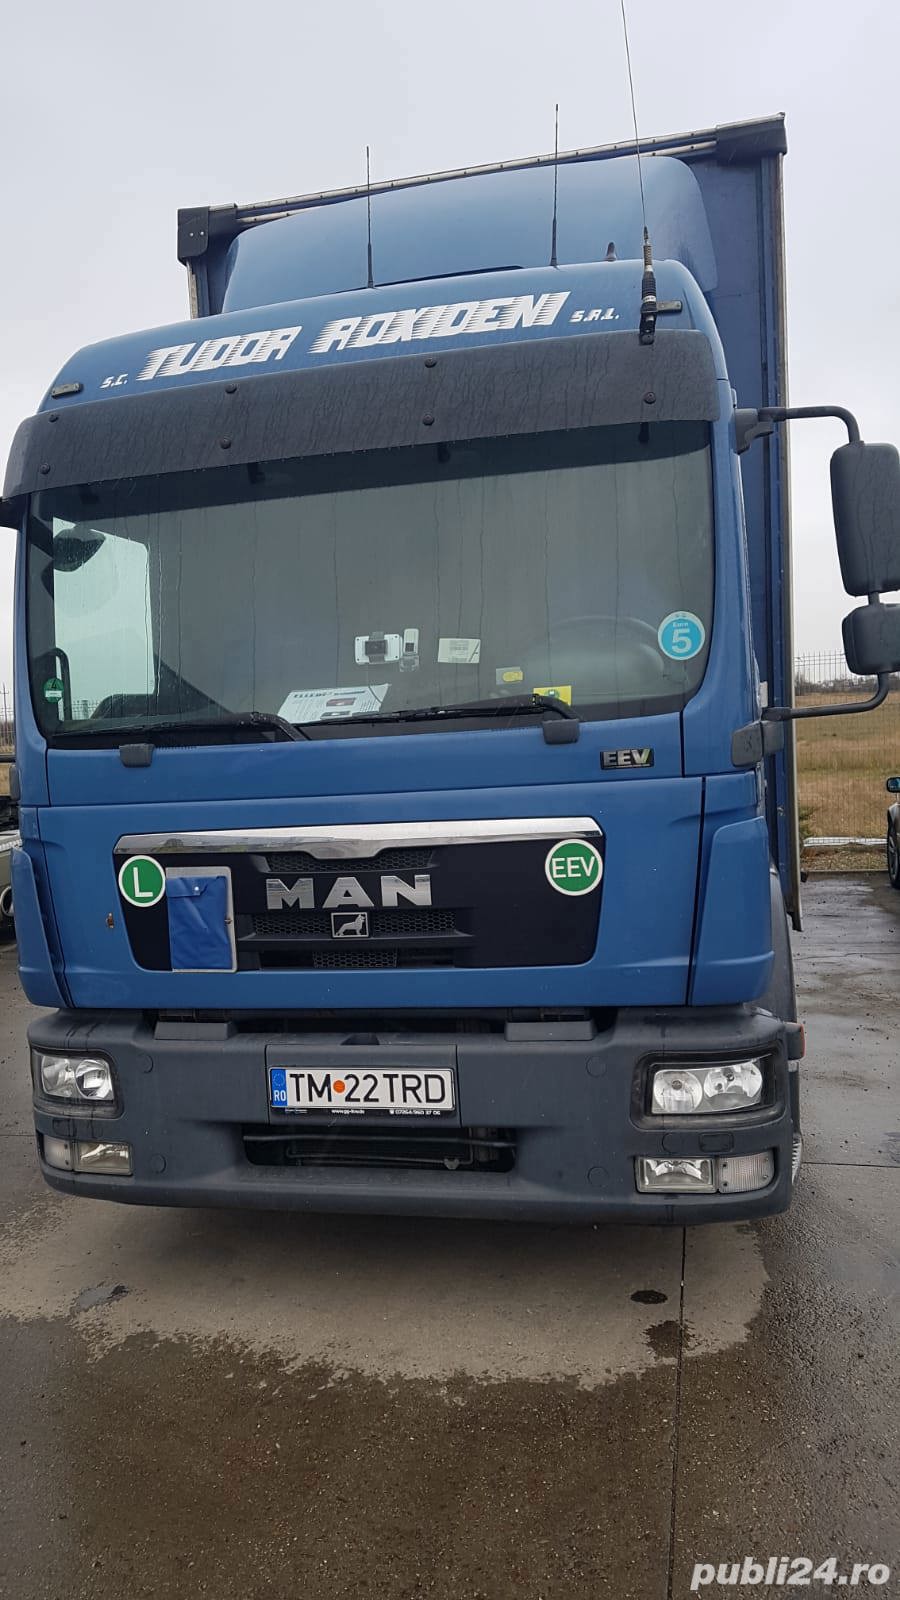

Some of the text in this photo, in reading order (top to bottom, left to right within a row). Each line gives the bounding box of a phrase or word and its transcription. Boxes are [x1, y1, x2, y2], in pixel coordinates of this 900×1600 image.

[100, 291, 620, 389] S.C. TUDOR ROXIDEN S.R.L.
[672, 628, 692, 654] 5
[603, 748, 650, 766] EEV
[552, 856, 596, 879] EEV
[133, 867, 154, 897] L
[266, 874, 433, 910] MAN
[273, 1089, 287, 1102] RO
